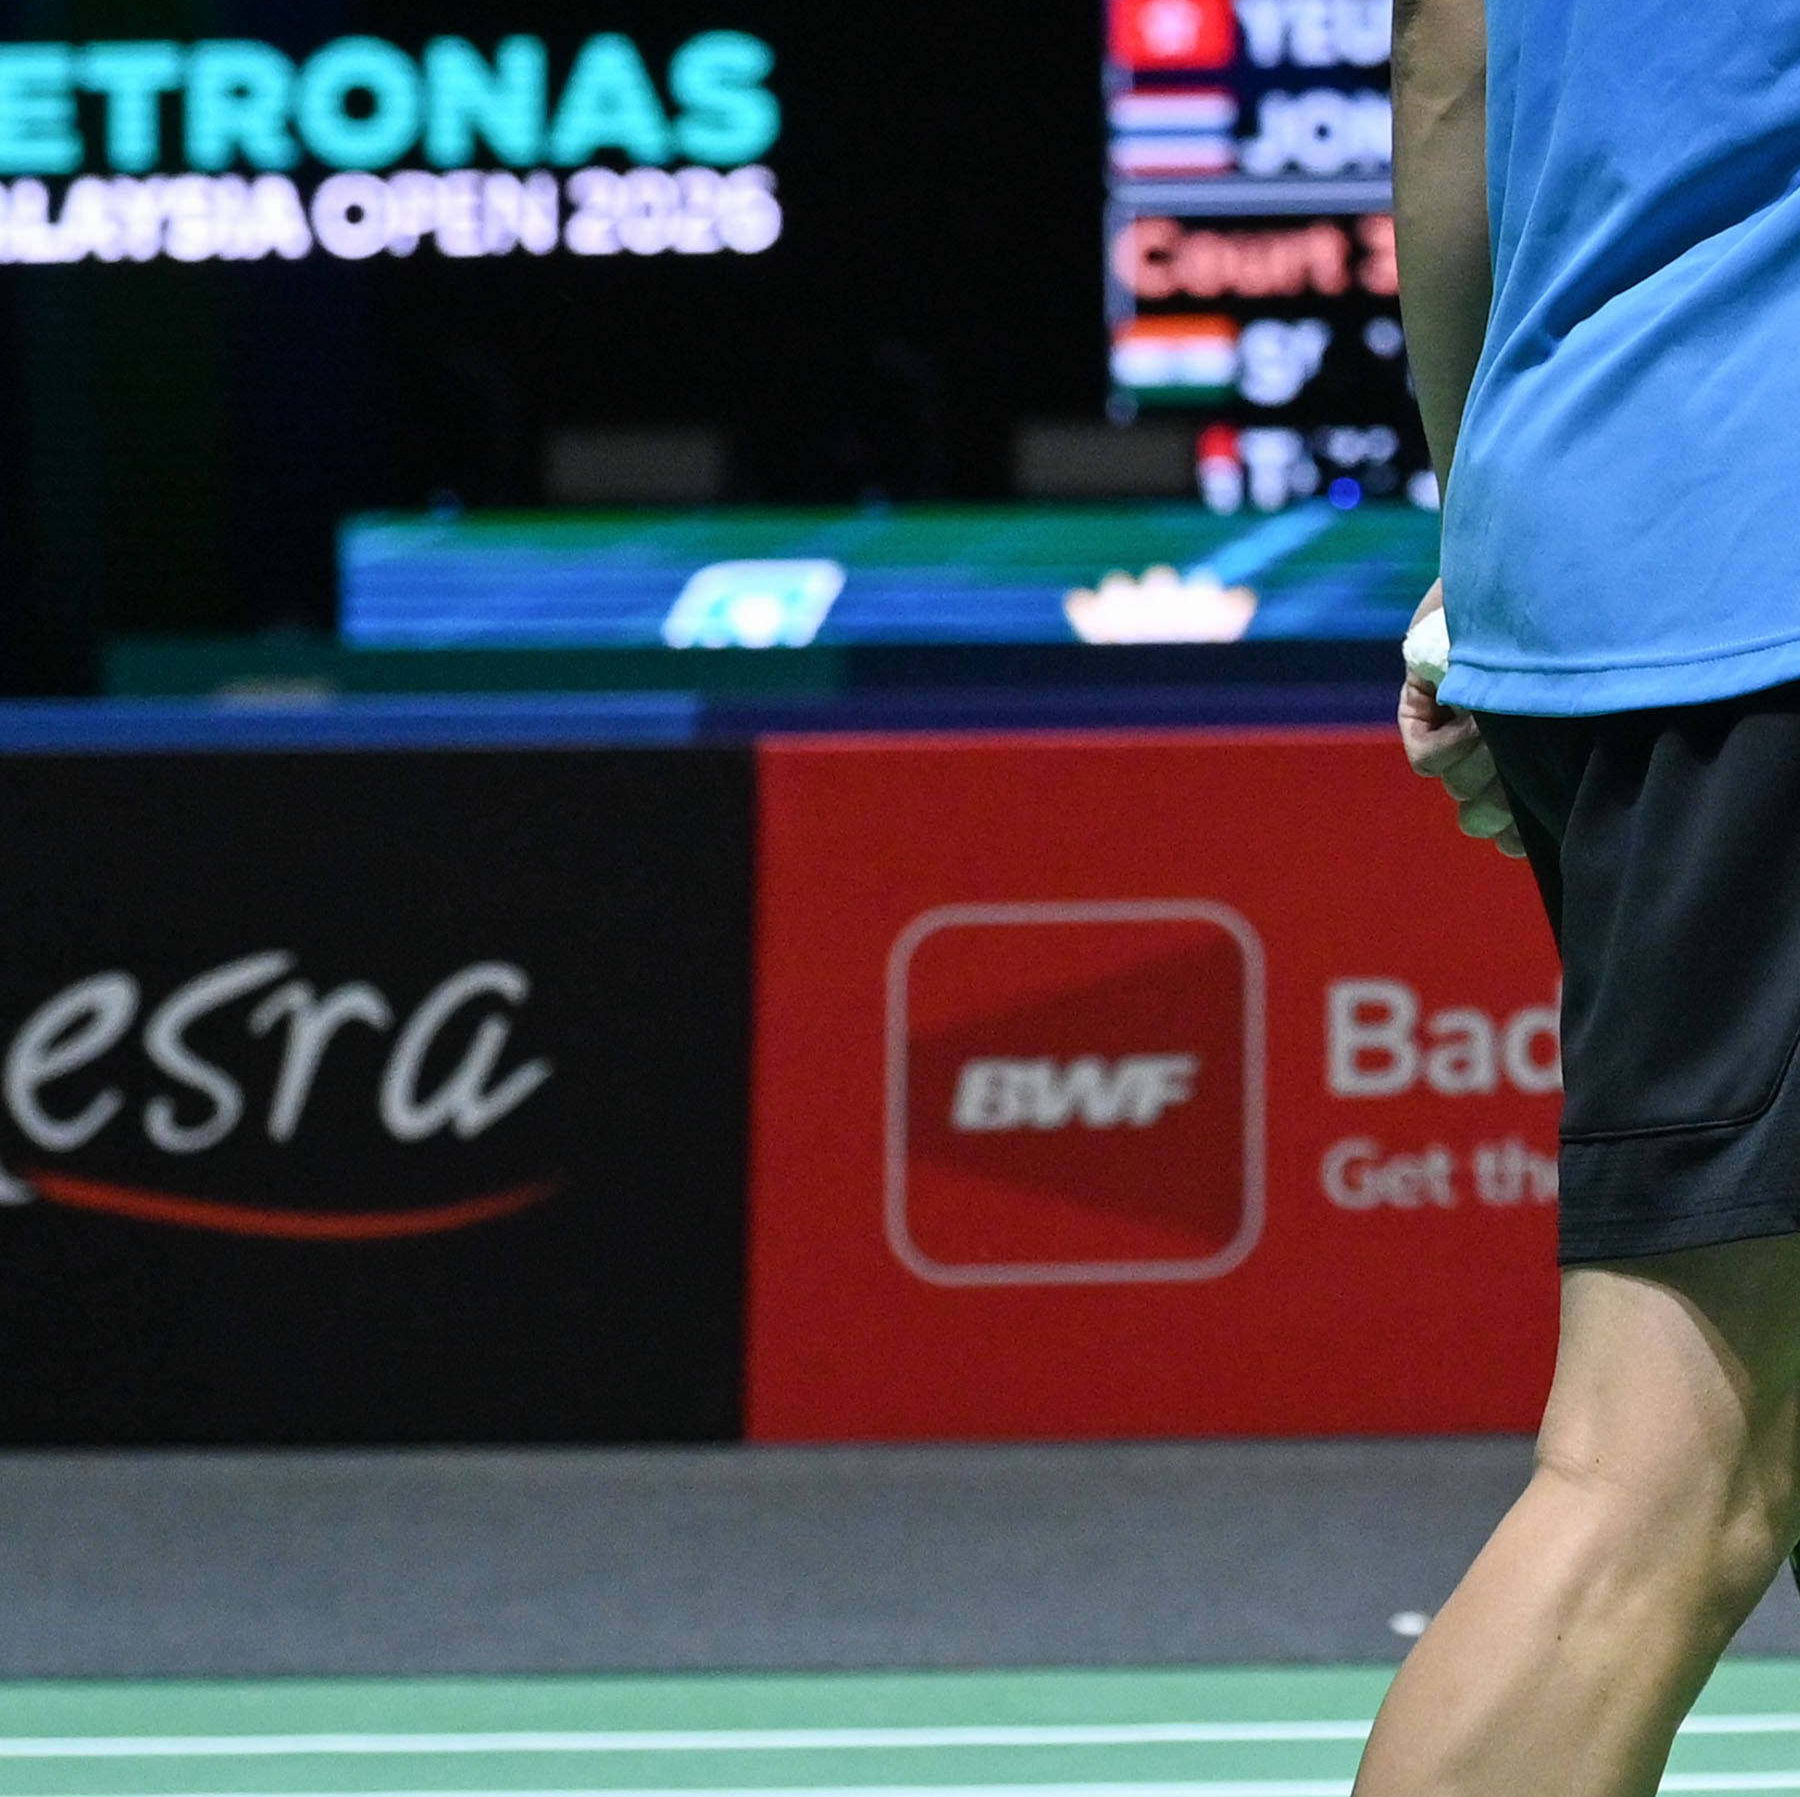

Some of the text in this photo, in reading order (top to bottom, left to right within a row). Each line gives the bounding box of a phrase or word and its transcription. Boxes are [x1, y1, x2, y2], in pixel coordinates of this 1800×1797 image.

[0, 30, 782, 172] ETRONAS
[0, 164, 784, 264] LAYSIA OPEN 2026
[1110, 215, 1350, 299] Court
[0, 947, 553, 1154] esra
[1325, 977, 1563, 1097] Bad
[949, 1053, 1199, 1132] BWF
[1320, 1135, 1456, 1210] Get
